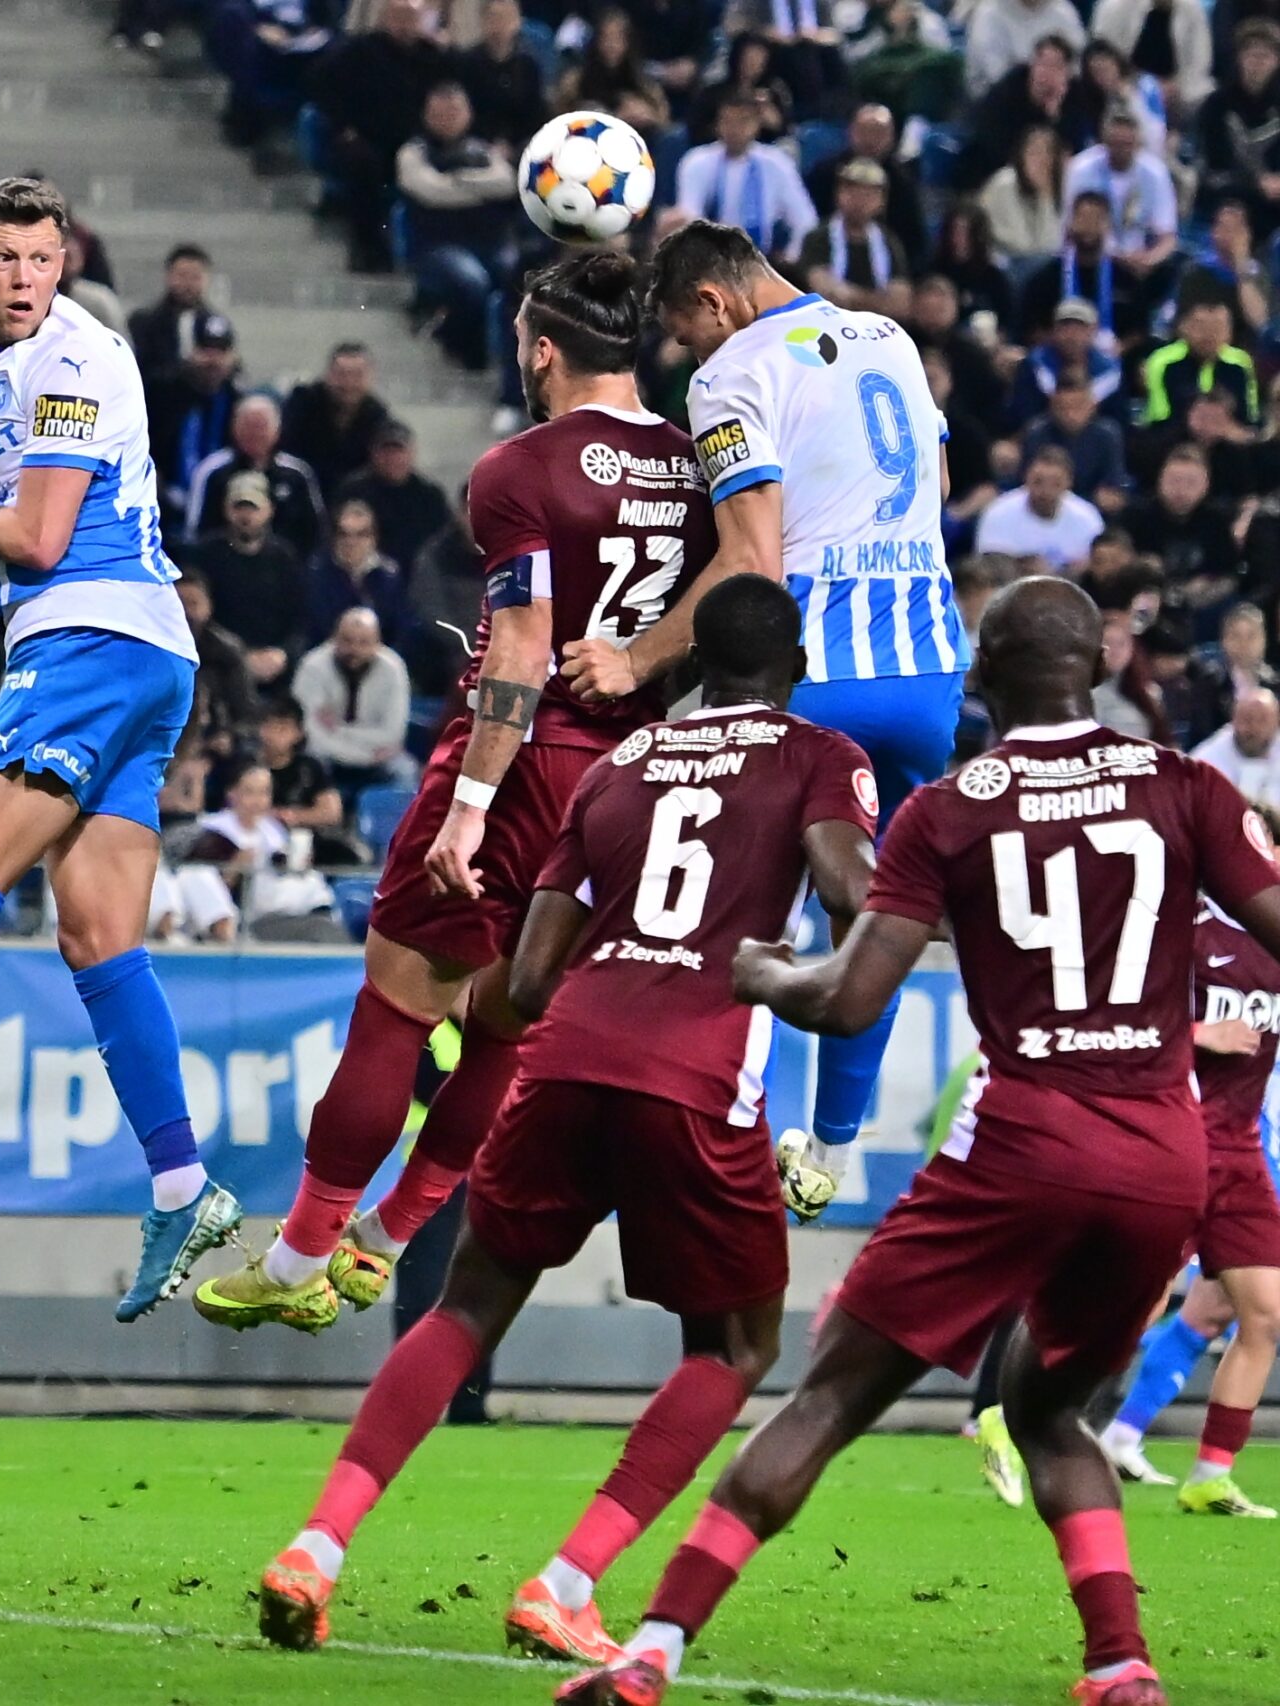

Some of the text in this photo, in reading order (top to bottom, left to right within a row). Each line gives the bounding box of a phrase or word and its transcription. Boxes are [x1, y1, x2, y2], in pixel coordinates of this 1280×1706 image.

[36, 396, 97, 423] Drinks
[43, 418, 93, 441] more
[698, 423, 744, 459] rinks
[618, 450, 669, 474] Roata
[708, 443, 749, 477] more
[855, 368, 920, 525] 9
[617, 498, 688, 528] MUNAR
[821, 545, 847, 577] AL
[655, 726, 722, 742] Roata
[642, 752, 747, 784] SINYAN
[1008, 743, 1158, 775] Roata Făget
[1018, 783, 1126, 822] BRAUN
[632, 786, 723, 940] 6
[991, 819, 1166, 1012] 47
[616, 939, 704, 971] ZeroBet
[1055, 1024, 1162, 1052] ZeroBet
